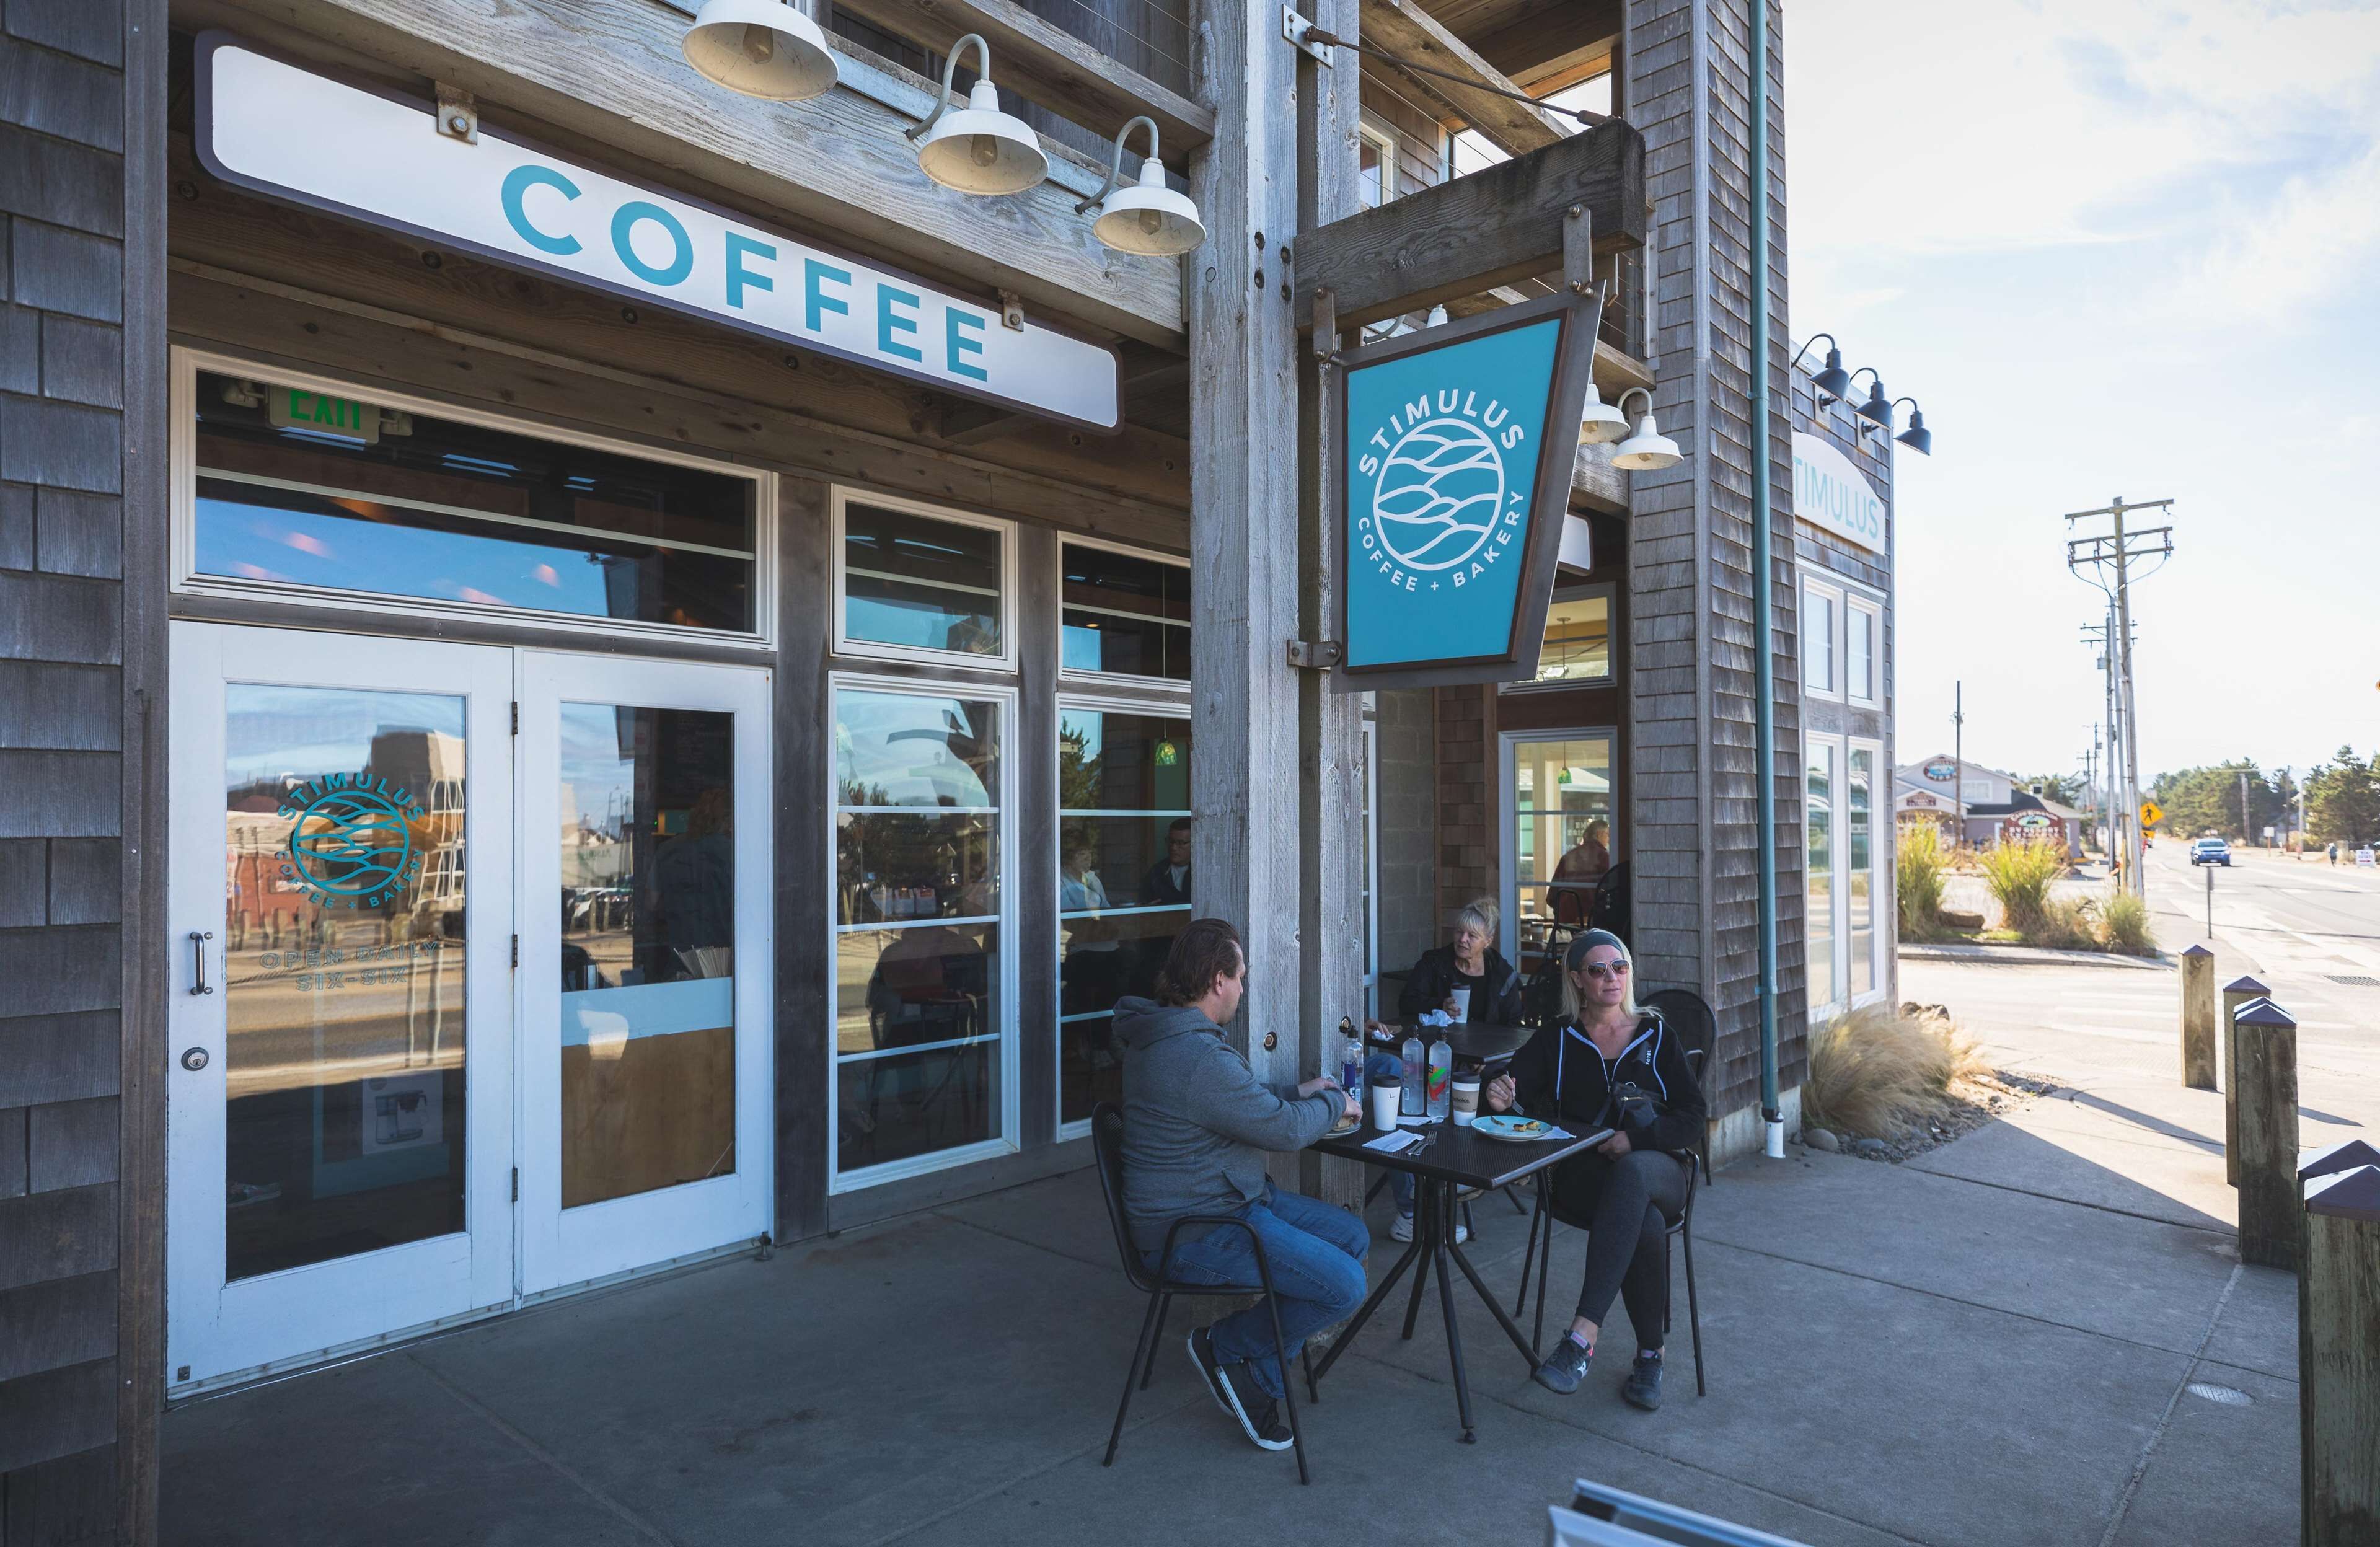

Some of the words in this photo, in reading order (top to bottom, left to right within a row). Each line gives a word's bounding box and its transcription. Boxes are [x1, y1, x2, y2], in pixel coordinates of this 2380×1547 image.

[500, 165, 989, 383] COFFEE
[1359, 389, 1525, 476] STIMULUS
[1793, 456, 1878, 539] TIMULUS
[1358, 517, 1417, 591] COFFEE
[1430, 581, 1439, 591] +
[1453, 490, 1525, 588] BAKERY
[278, 770, 425, 821] STIMULUS
[276, 850, 335, 908] COFFEE
[369, 848, 426, 908] BAKERY
[260, 948, 343, 969] OPEN
[356, 941, 438, 963] DAILY
[296, 966, 408, 992] SIX-SIX
